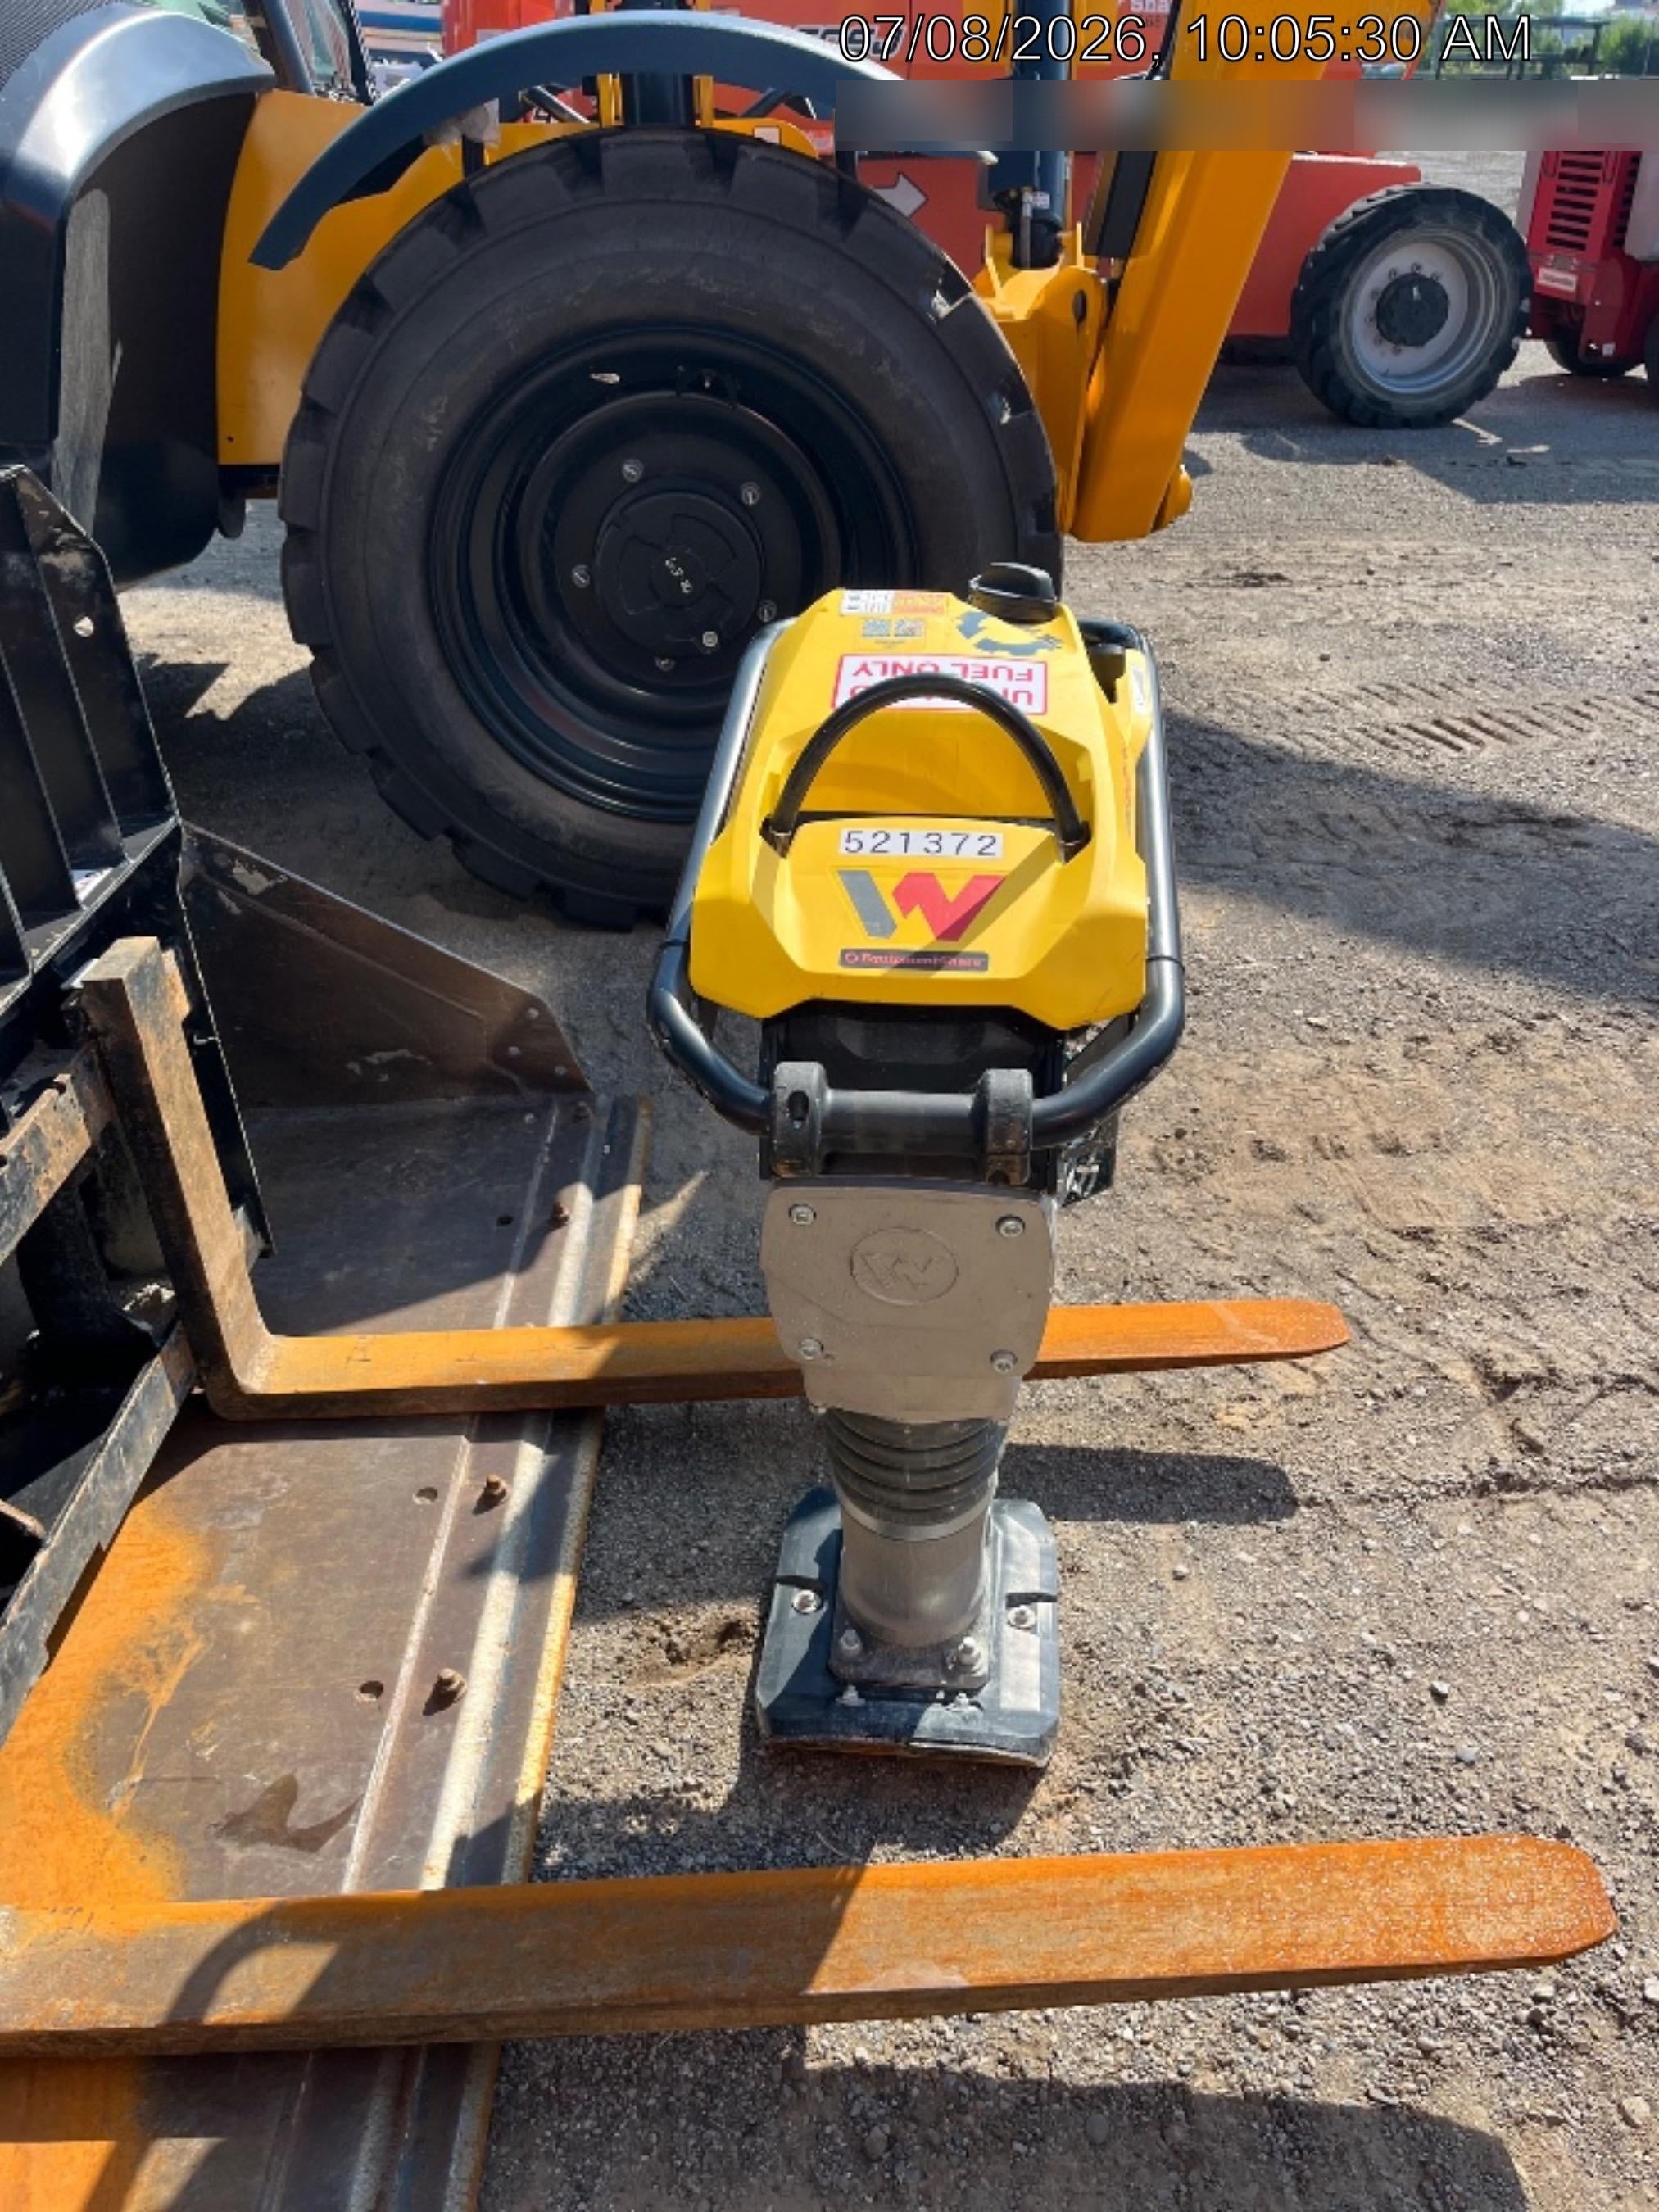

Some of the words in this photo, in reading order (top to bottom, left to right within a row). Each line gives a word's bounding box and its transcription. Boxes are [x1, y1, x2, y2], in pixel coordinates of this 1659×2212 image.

[852, 660, 940, 677] ONLY
[950, 662, 1033, 682] FUEL
[845, 830, 997, 855] 521372
